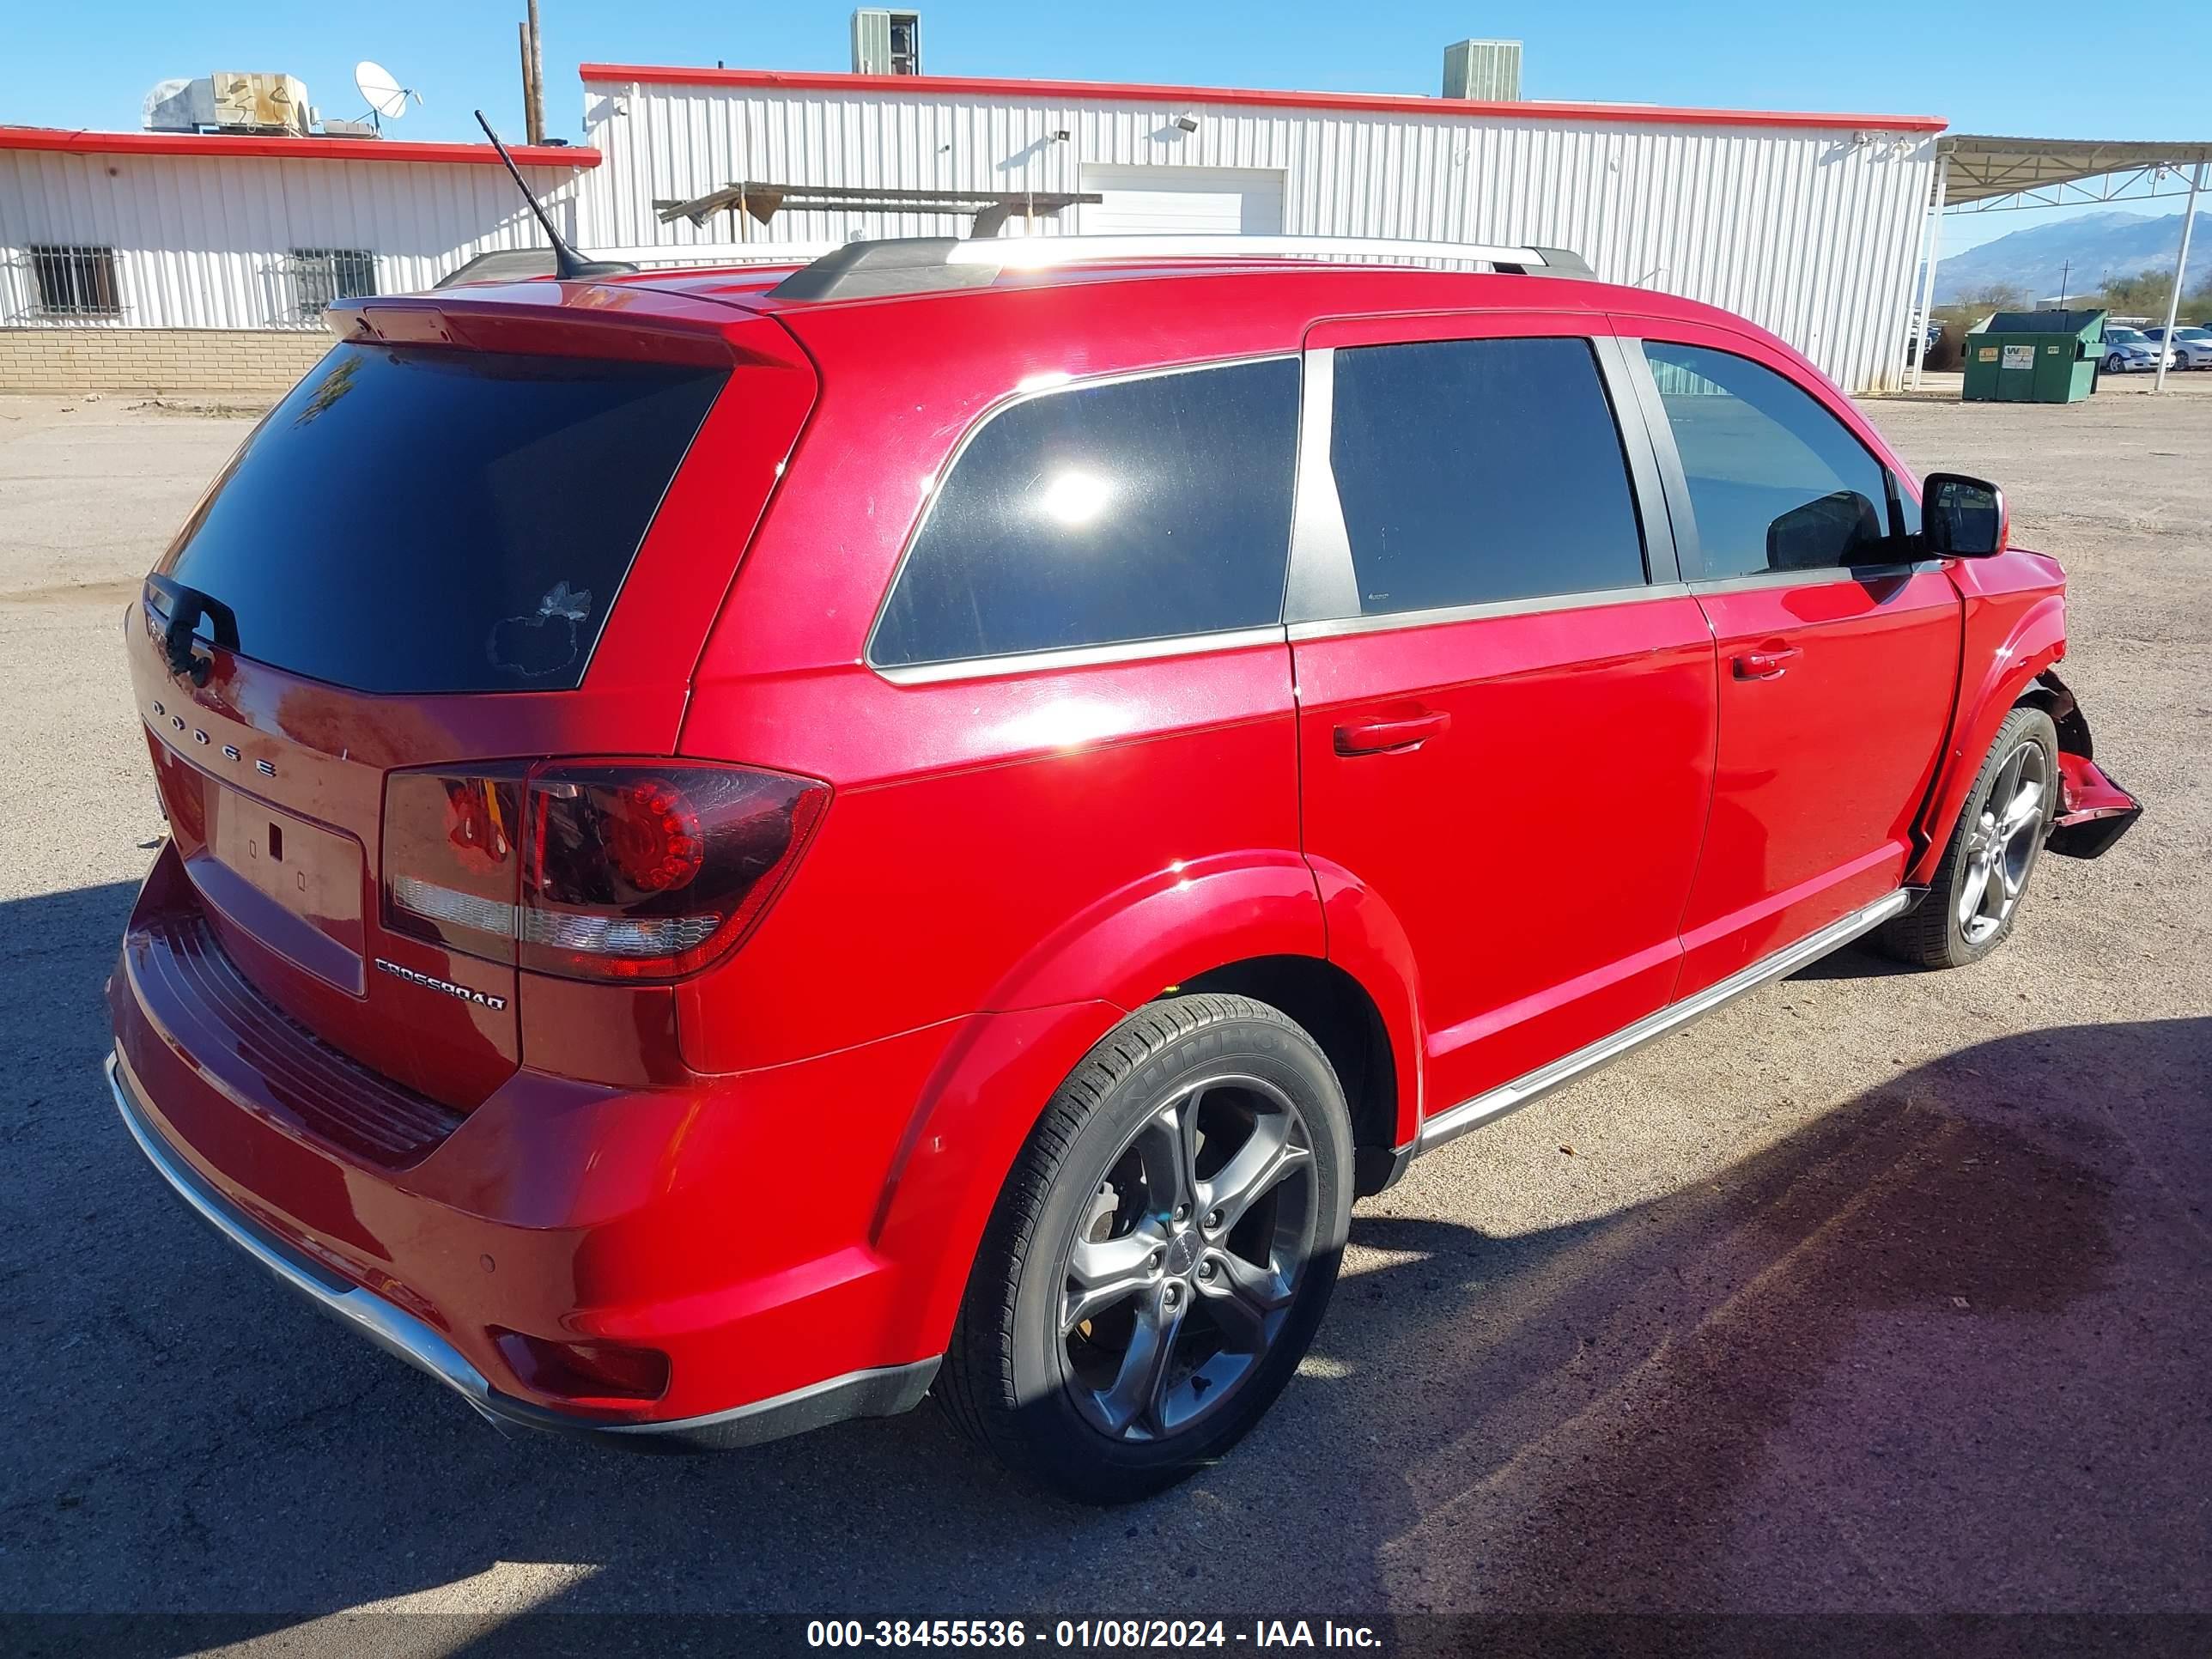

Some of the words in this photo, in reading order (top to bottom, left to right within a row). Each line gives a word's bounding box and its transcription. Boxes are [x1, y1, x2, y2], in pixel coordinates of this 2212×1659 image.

[152, 700, 276, 777] DODGE
[374, 957, 507, 1011] CROSSROAD
[1106, 1027, 1281, 1128] KUMHO
